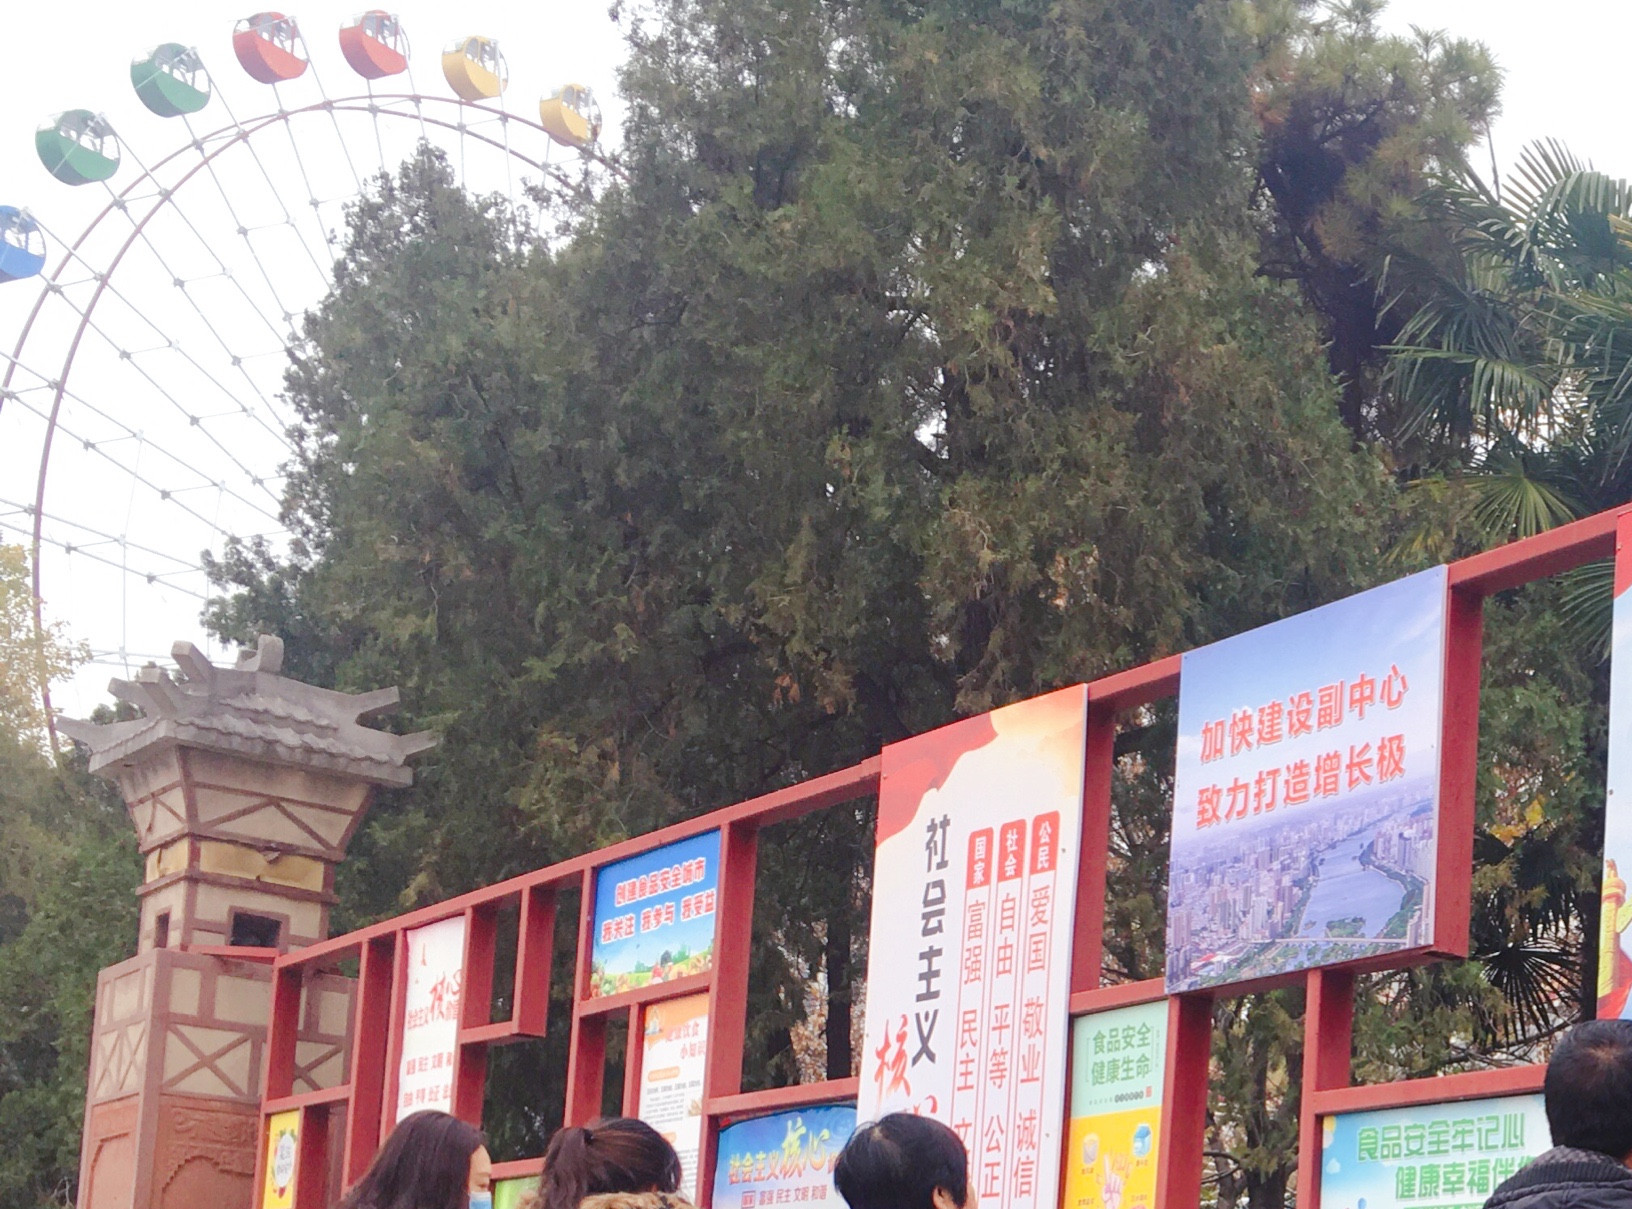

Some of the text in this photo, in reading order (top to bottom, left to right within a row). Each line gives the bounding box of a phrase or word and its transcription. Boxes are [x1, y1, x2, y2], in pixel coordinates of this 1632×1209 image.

[1200, 664, 1408, 764] 加快建设副中心
[1196, 734, 1405, 829] 致力打造增长极
[616, 858, 705, 906] 创建食品安全城市
[973, 836, 986, 884] 国家
[1004, 829, 1018, 876] 社会
[1037, 821, 1051, 869] 公民
[602, 914, 635, 942] 我关注
[641, 903, 675, 932] 我参与
[912, 814, 950, 1067] 社会主义
[964, 899, 986, 984] 富强
[996, 893, 1016, 978] 自由
[1027, 885, 1050, 975] 爱国
[957, 1010, 978, 1092] 民主
[989, 1004, 1010, 1090] 平等
[1020, 997, 1044, 1084] 敬业
[1091, 1053, 1151, 1086] 健康生命
[1093, 1022, 1151, 1055] 食品安全
[982, 1114, 1004, 1198] 公正
[1013, 1109, 1035, 1197] 诚信
[1357, 1113, 1525, 1162] 食品安全牢记心
[776, 1187, 791, 1203] 民主
[794, 1186, 809, 1202] 文明
